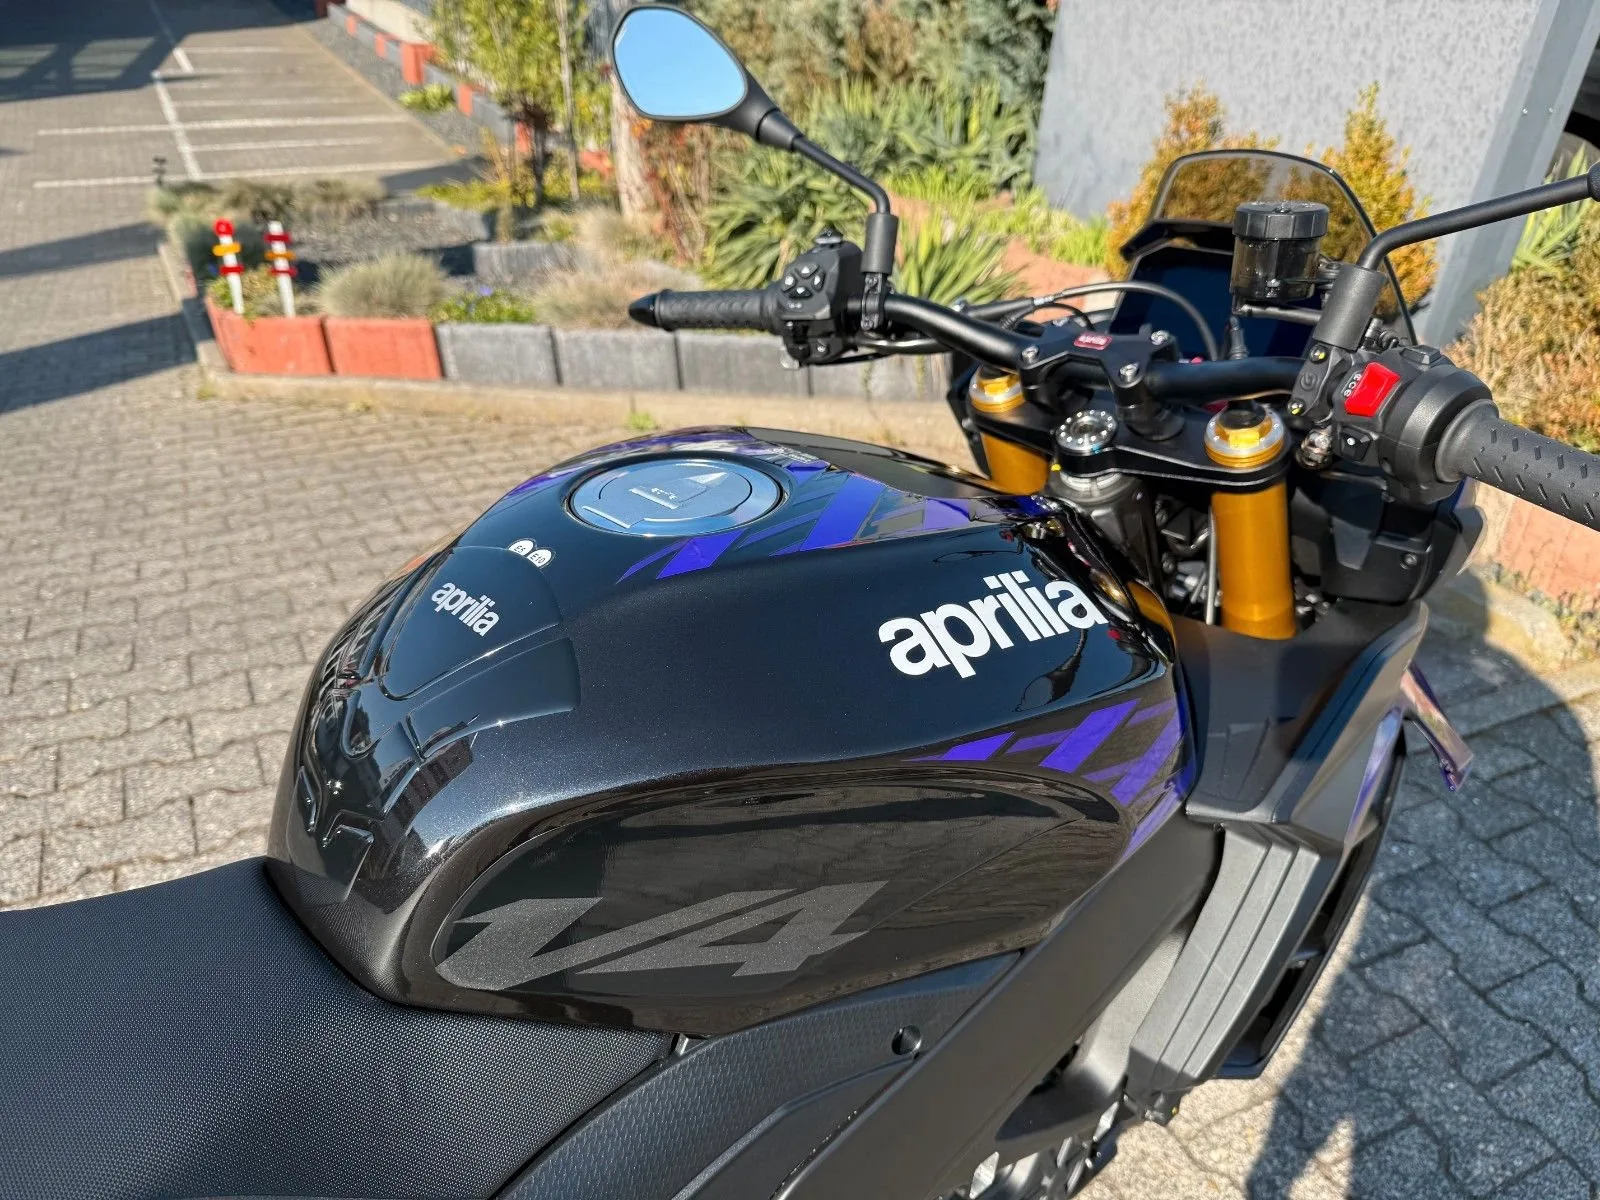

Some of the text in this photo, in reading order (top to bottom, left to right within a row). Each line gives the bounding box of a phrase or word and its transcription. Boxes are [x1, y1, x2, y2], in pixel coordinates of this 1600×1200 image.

[513, 545, 527, 554] E5
[529, 553, 546, 564] E10
[431, 582, 500, 636] aprilia
[878, 569, 1109, 679] aprilia
[435, 880, 889, 991] V4
